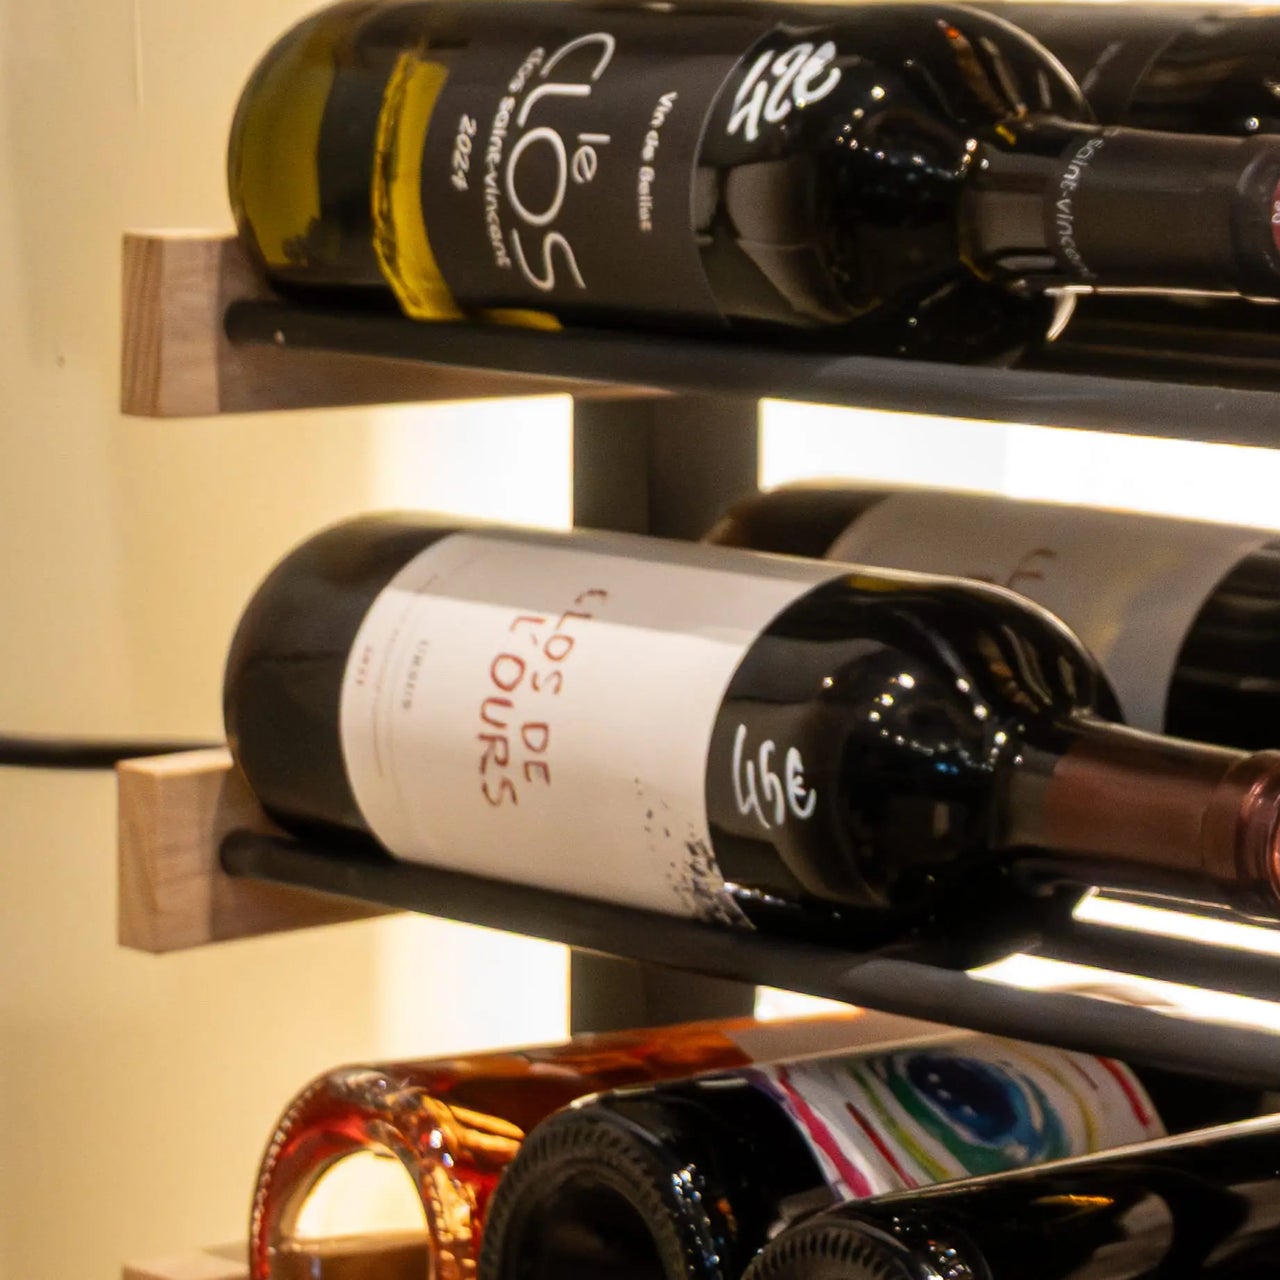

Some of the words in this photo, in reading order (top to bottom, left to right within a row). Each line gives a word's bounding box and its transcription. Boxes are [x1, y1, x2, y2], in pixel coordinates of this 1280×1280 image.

[507, 31, 616, 293] CLOS
[572, 132, 611, 184] le
[532, 587, 609, 696] CLOS
[476, 614, 546, 807] L'OURS
[520, 721, 551, 785] DE
[732, 723, 816, 829] 45€
